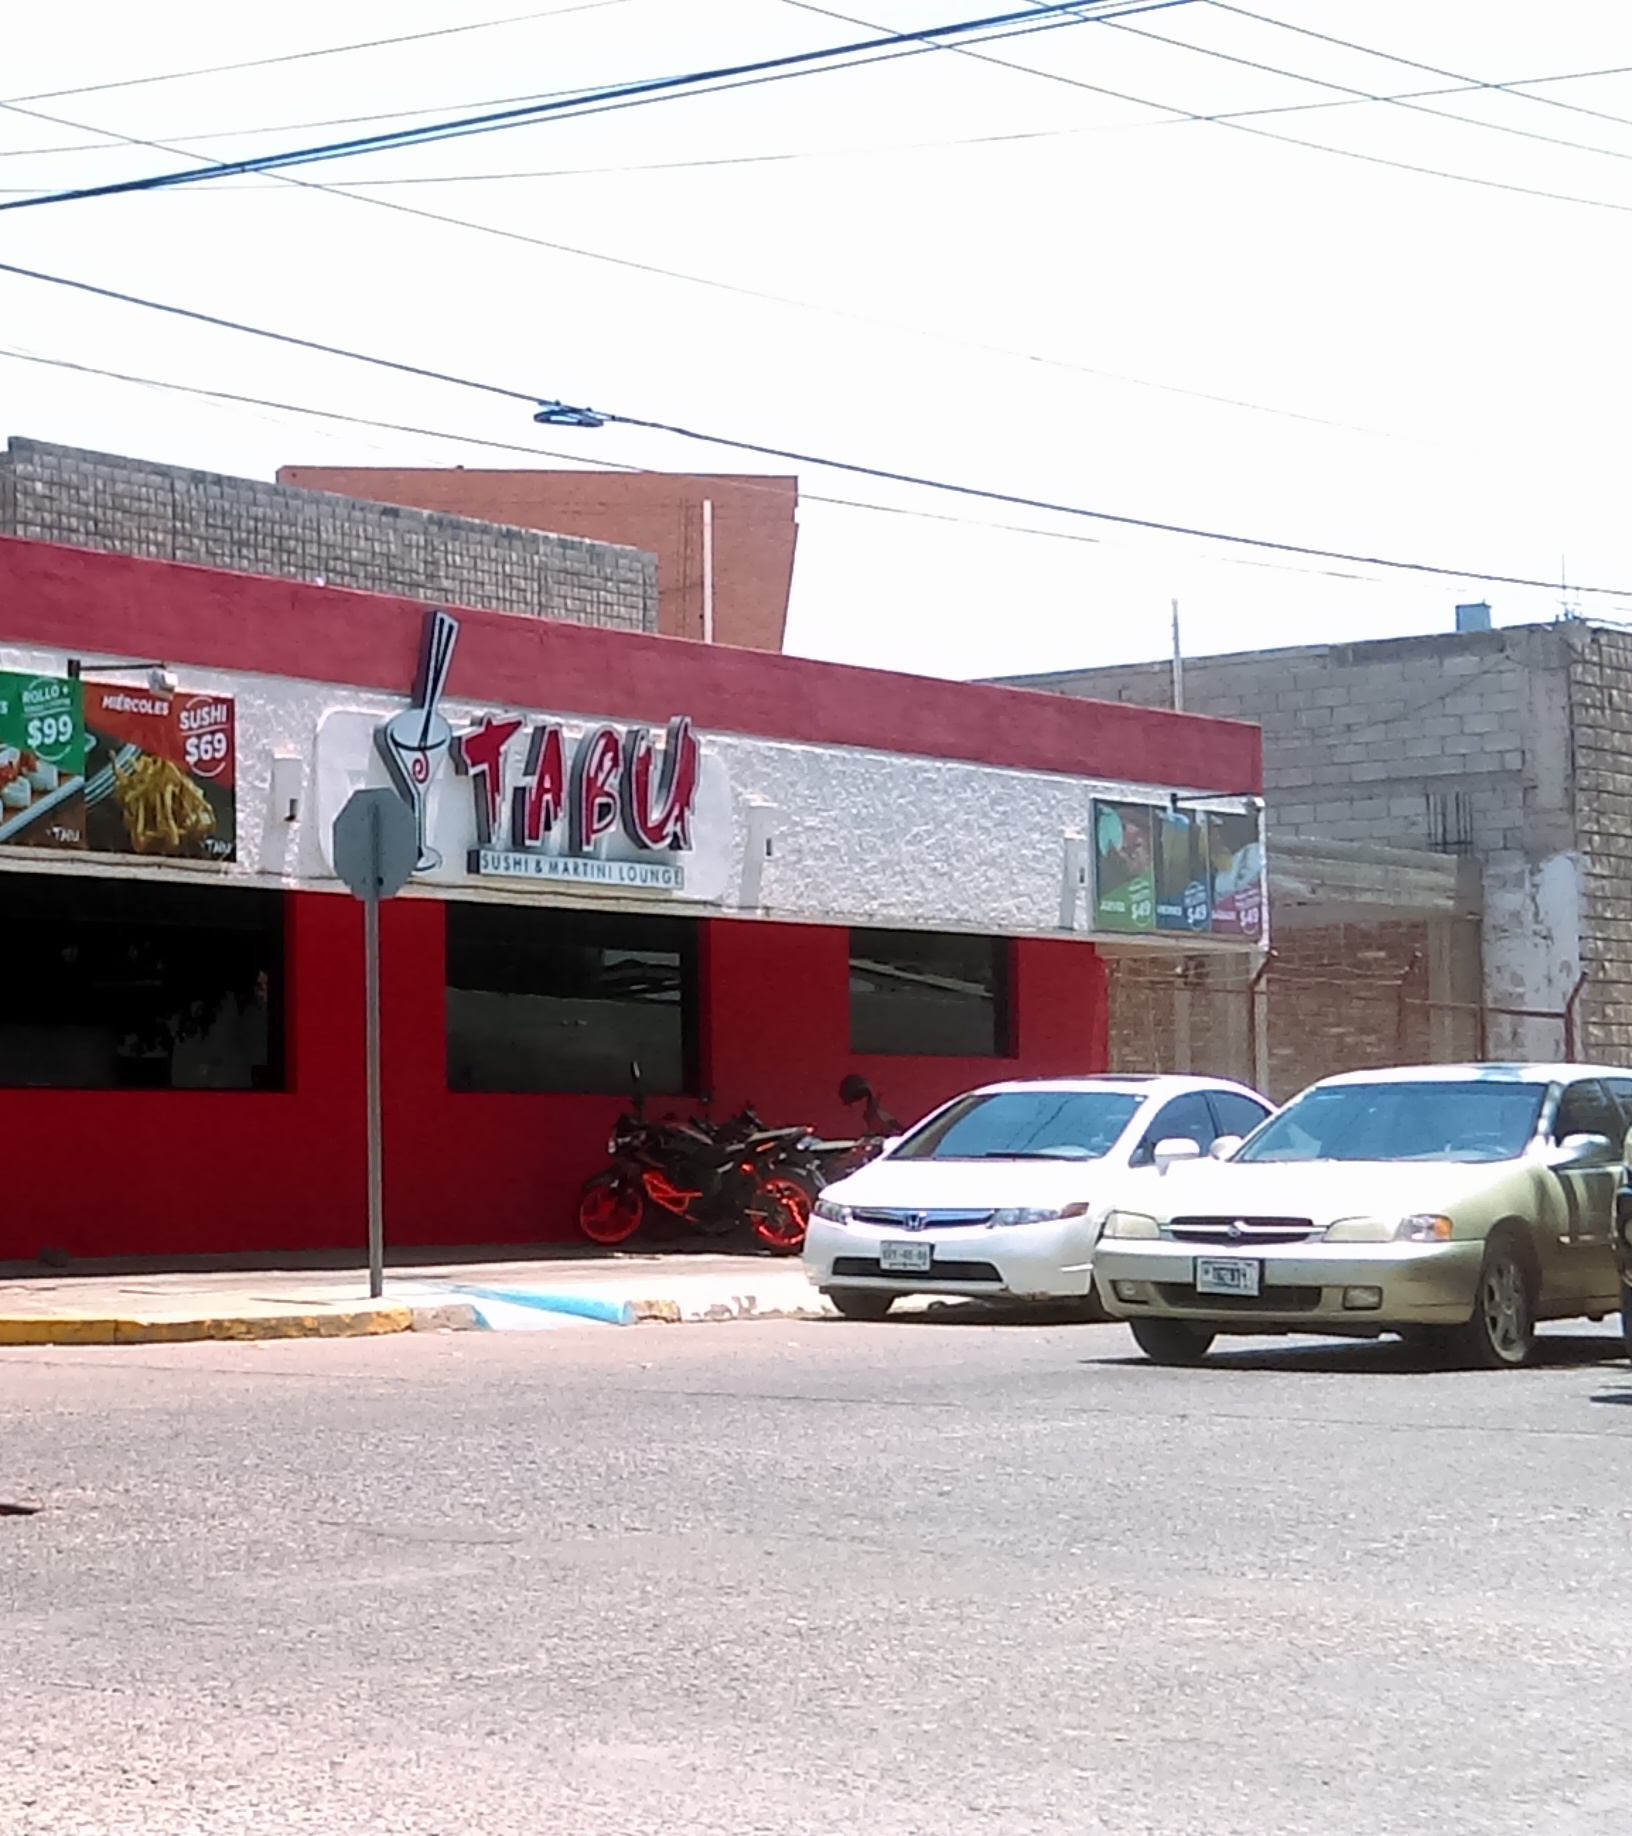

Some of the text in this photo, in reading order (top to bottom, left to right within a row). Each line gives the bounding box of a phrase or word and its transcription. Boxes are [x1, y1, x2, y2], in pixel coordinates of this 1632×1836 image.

[22, 684, 60, 703] ROLLO
[27, 714, 73, 748] $99
[179, 704, 227, 730] SUSHI
[185, 732, 227, 764] $69
[453, 714, 701, 852] TABU
[482, 854, 682, 886] SUSHI & MARTINI LOUNGE
